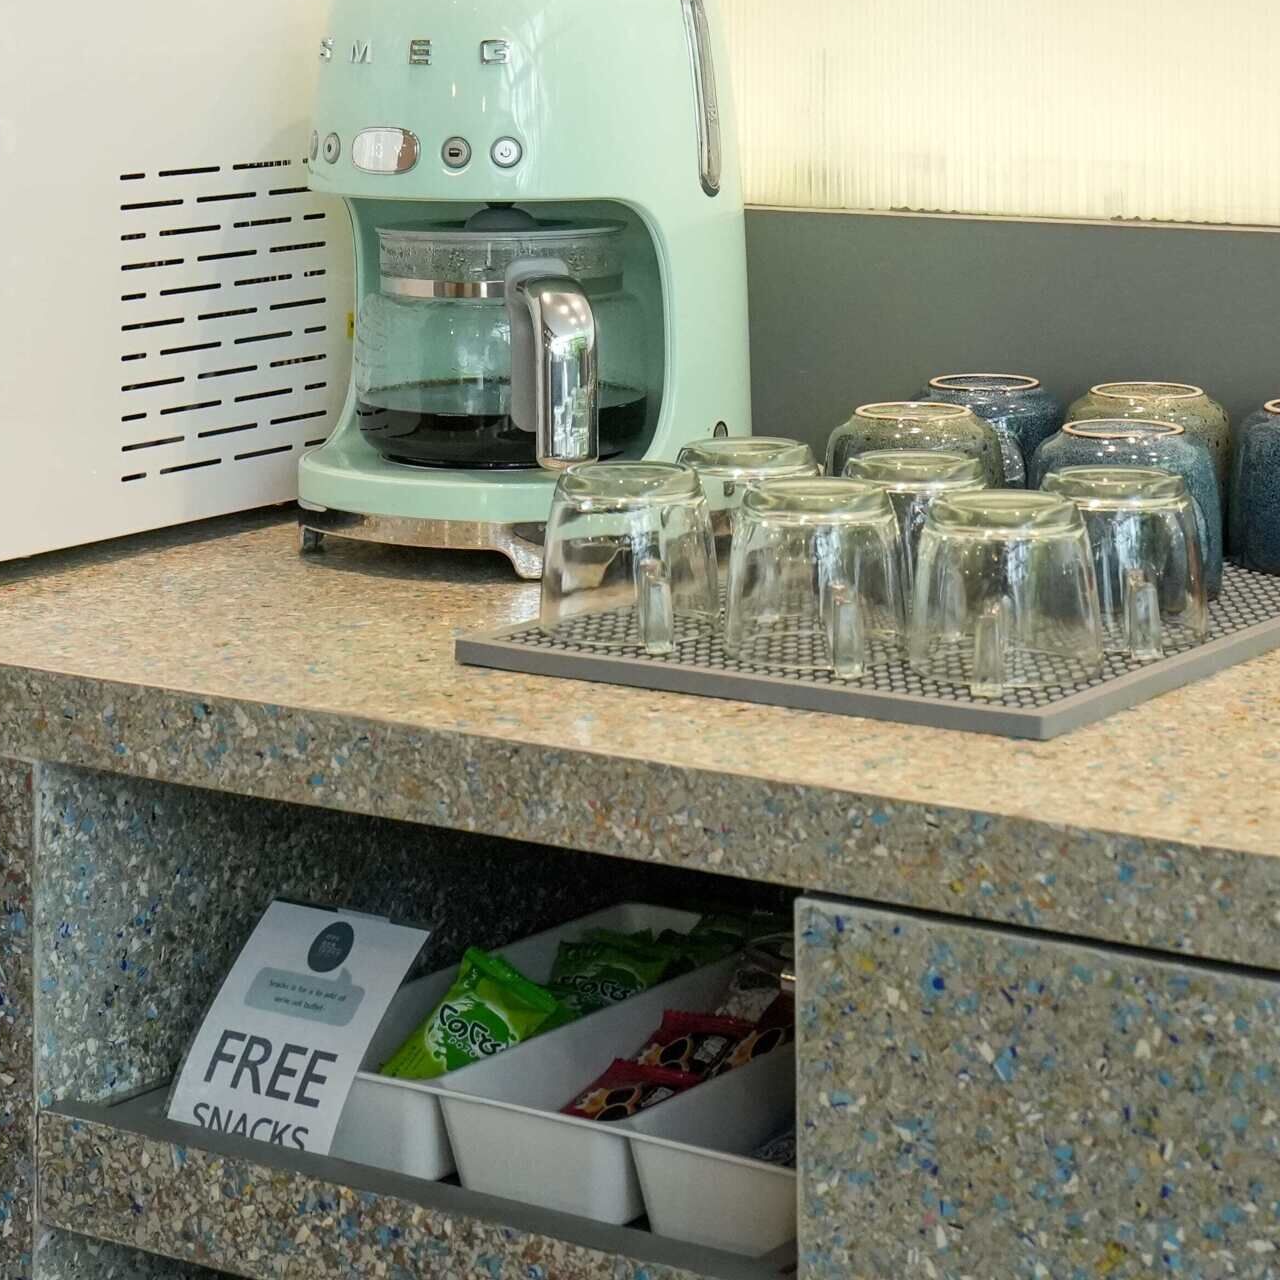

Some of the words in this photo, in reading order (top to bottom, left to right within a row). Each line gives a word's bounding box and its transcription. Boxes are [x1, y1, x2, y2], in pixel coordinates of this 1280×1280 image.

[320, 37, 513, 66] SMEG
[203, 1029, 339, 1108] FREE
[193, 1102, 310, 1150] SNACKS
